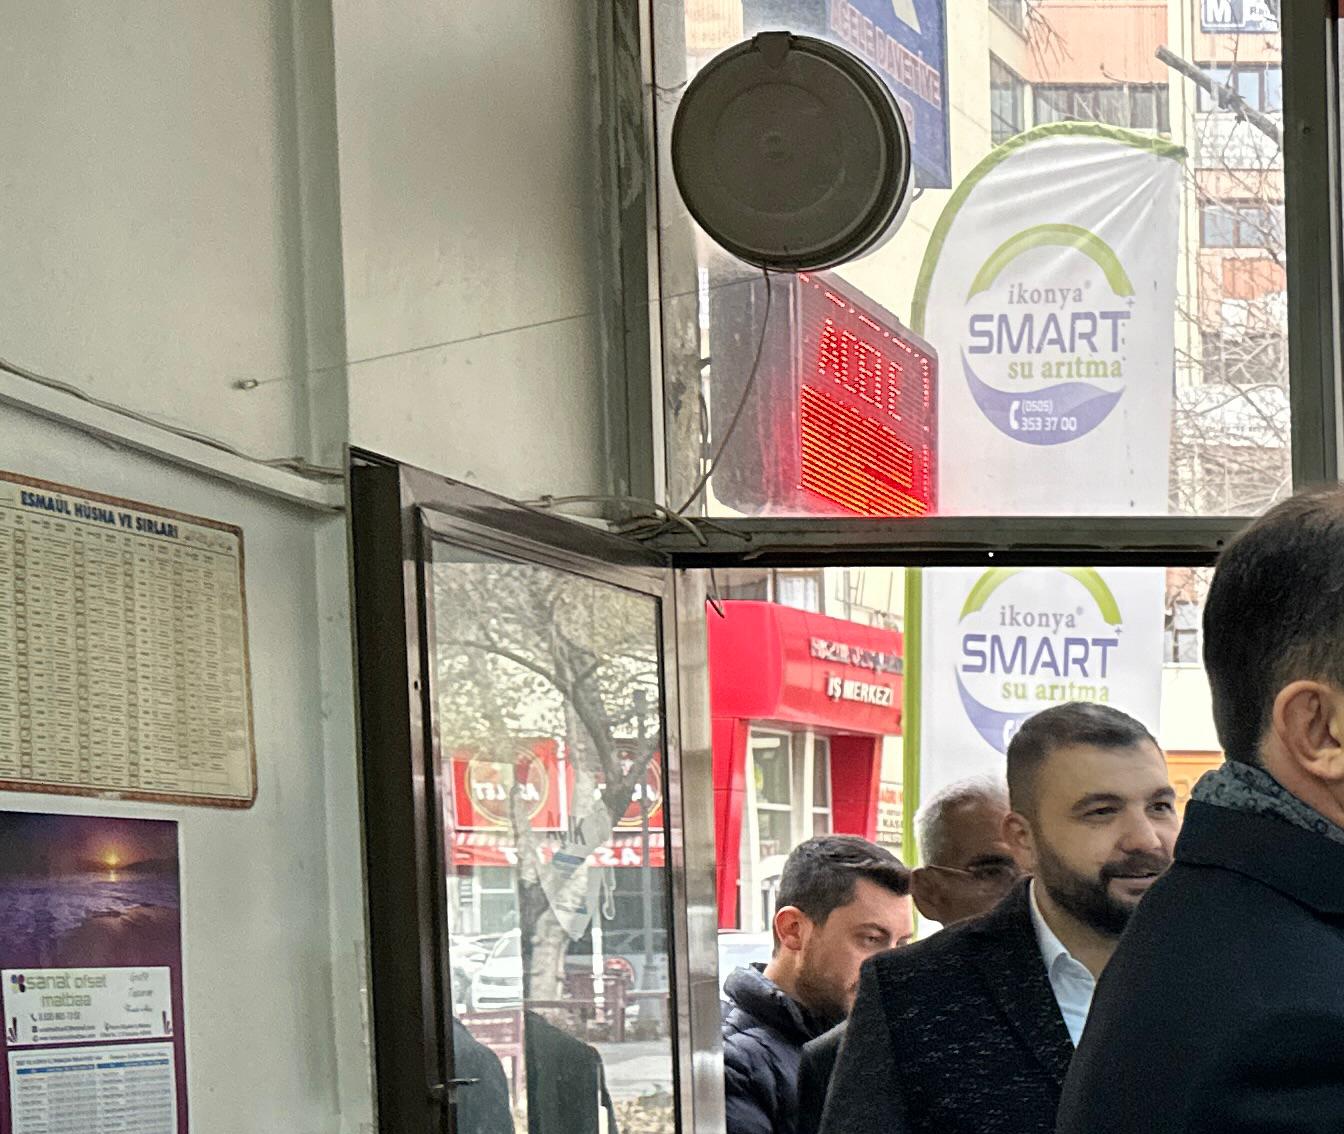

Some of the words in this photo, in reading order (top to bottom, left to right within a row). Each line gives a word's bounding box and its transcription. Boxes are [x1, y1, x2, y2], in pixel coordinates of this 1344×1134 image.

[1008, 283, 1084, 310] ikonya
[968, 311, 1131, 354] SMART
[1008, 361, 1034, 379] su
[1040, 356, 1123, 379] arıtma
[1021, 417, 1043, 431] 353
[1044, 417, 1058, 431] 37
[1060, 417, 1077, 431] 00
[999, 604, 1076, 634] ikonya
[962, 633, 1120, 679] SMART
[1002, 682, 1027, 701] su
[1035, 679, 1110, 702] arıtma
